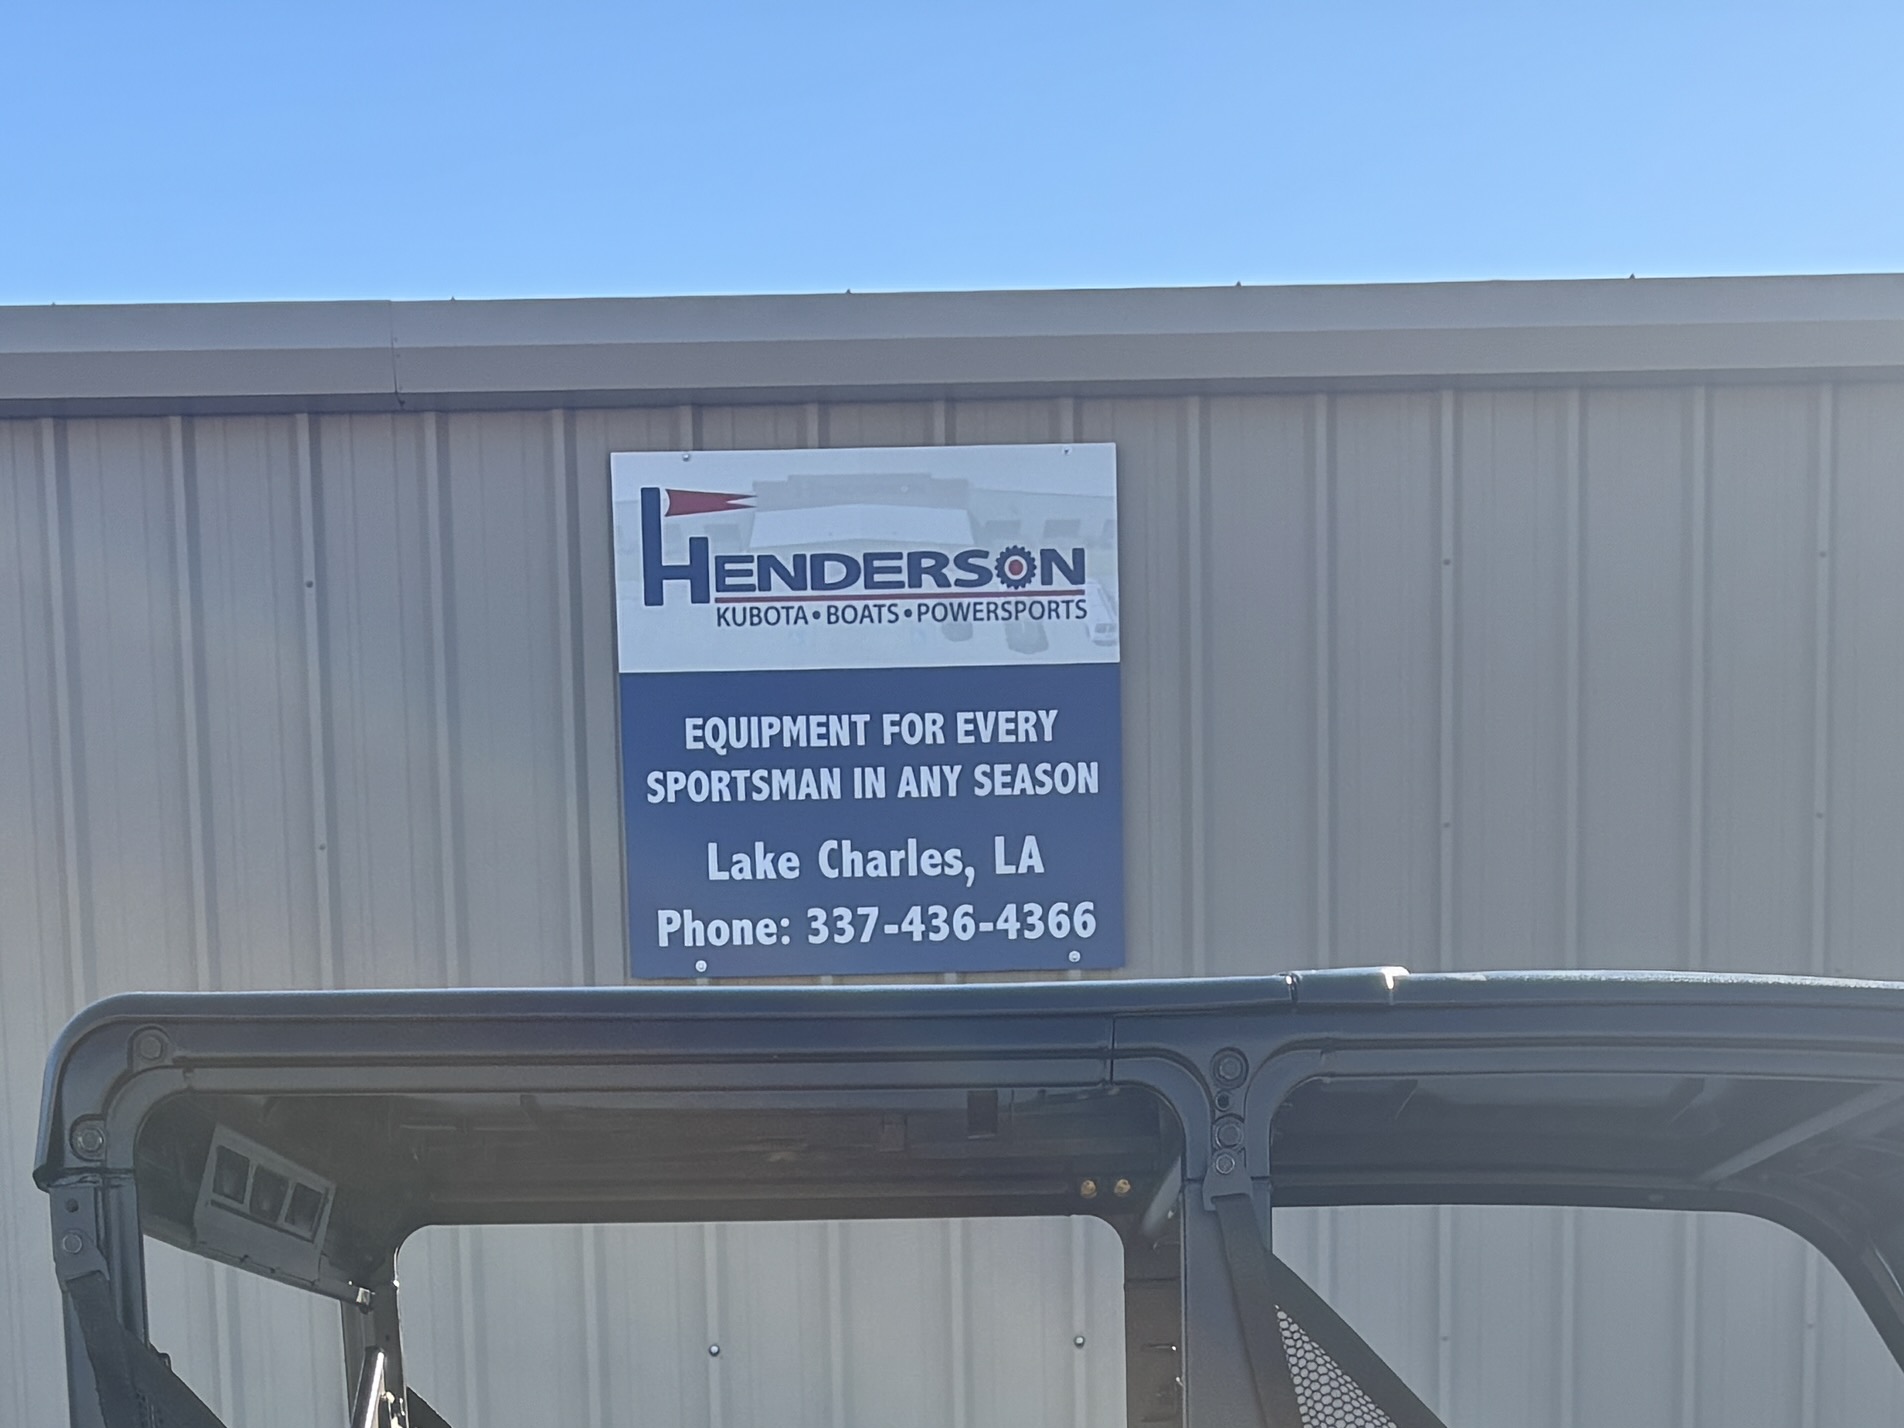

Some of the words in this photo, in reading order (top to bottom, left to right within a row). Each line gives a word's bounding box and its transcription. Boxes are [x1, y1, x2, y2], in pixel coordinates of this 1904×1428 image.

[641, 487, 1086, 606] HENDERSON
[685, 715, 870, 755] EQUIPMENT
[883, 712, 944, 745] FOR
[956, 710, 1058, 744] EVERY
[646, 767, 841, 803] SPORTSMAN
[854, 767, 886, 799] IN
[898, 765, 962, 798] ANY
[974, 762, 1099, 797] SEASON
[707, 842, 800, 880] Lake
[818, 838, 976, 887] Charles,
[994, 835, 1044, 874] LA
[658, 909, 791, 947] Phone:
[807, 901, 1096, 944] 337-436-4366
